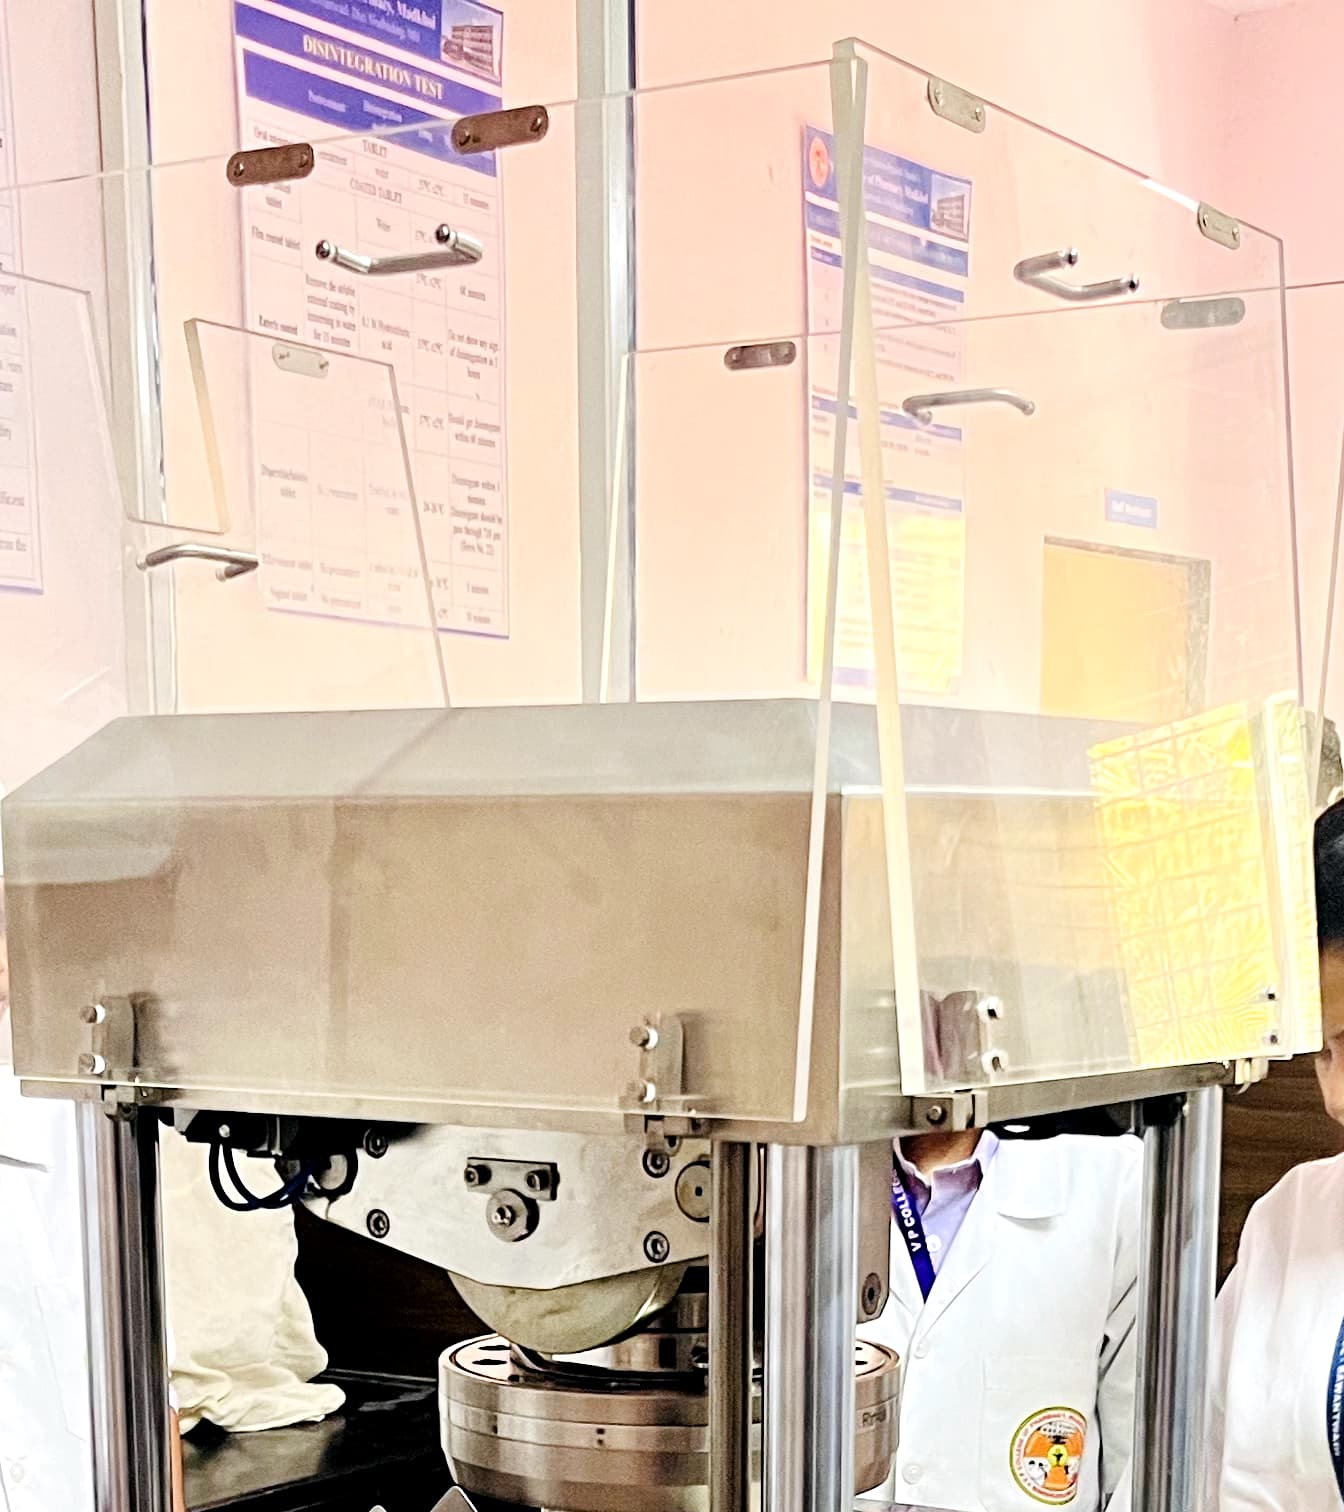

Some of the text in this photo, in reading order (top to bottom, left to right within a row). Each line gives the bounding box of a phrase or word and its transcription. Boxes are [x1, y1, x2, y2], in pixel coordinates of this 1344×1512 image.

[302, 34, 444, 100] DISINTEGRATION TEST
[908, 1229, 919, 1239] P
[911, 1241, 922, 1252] V
